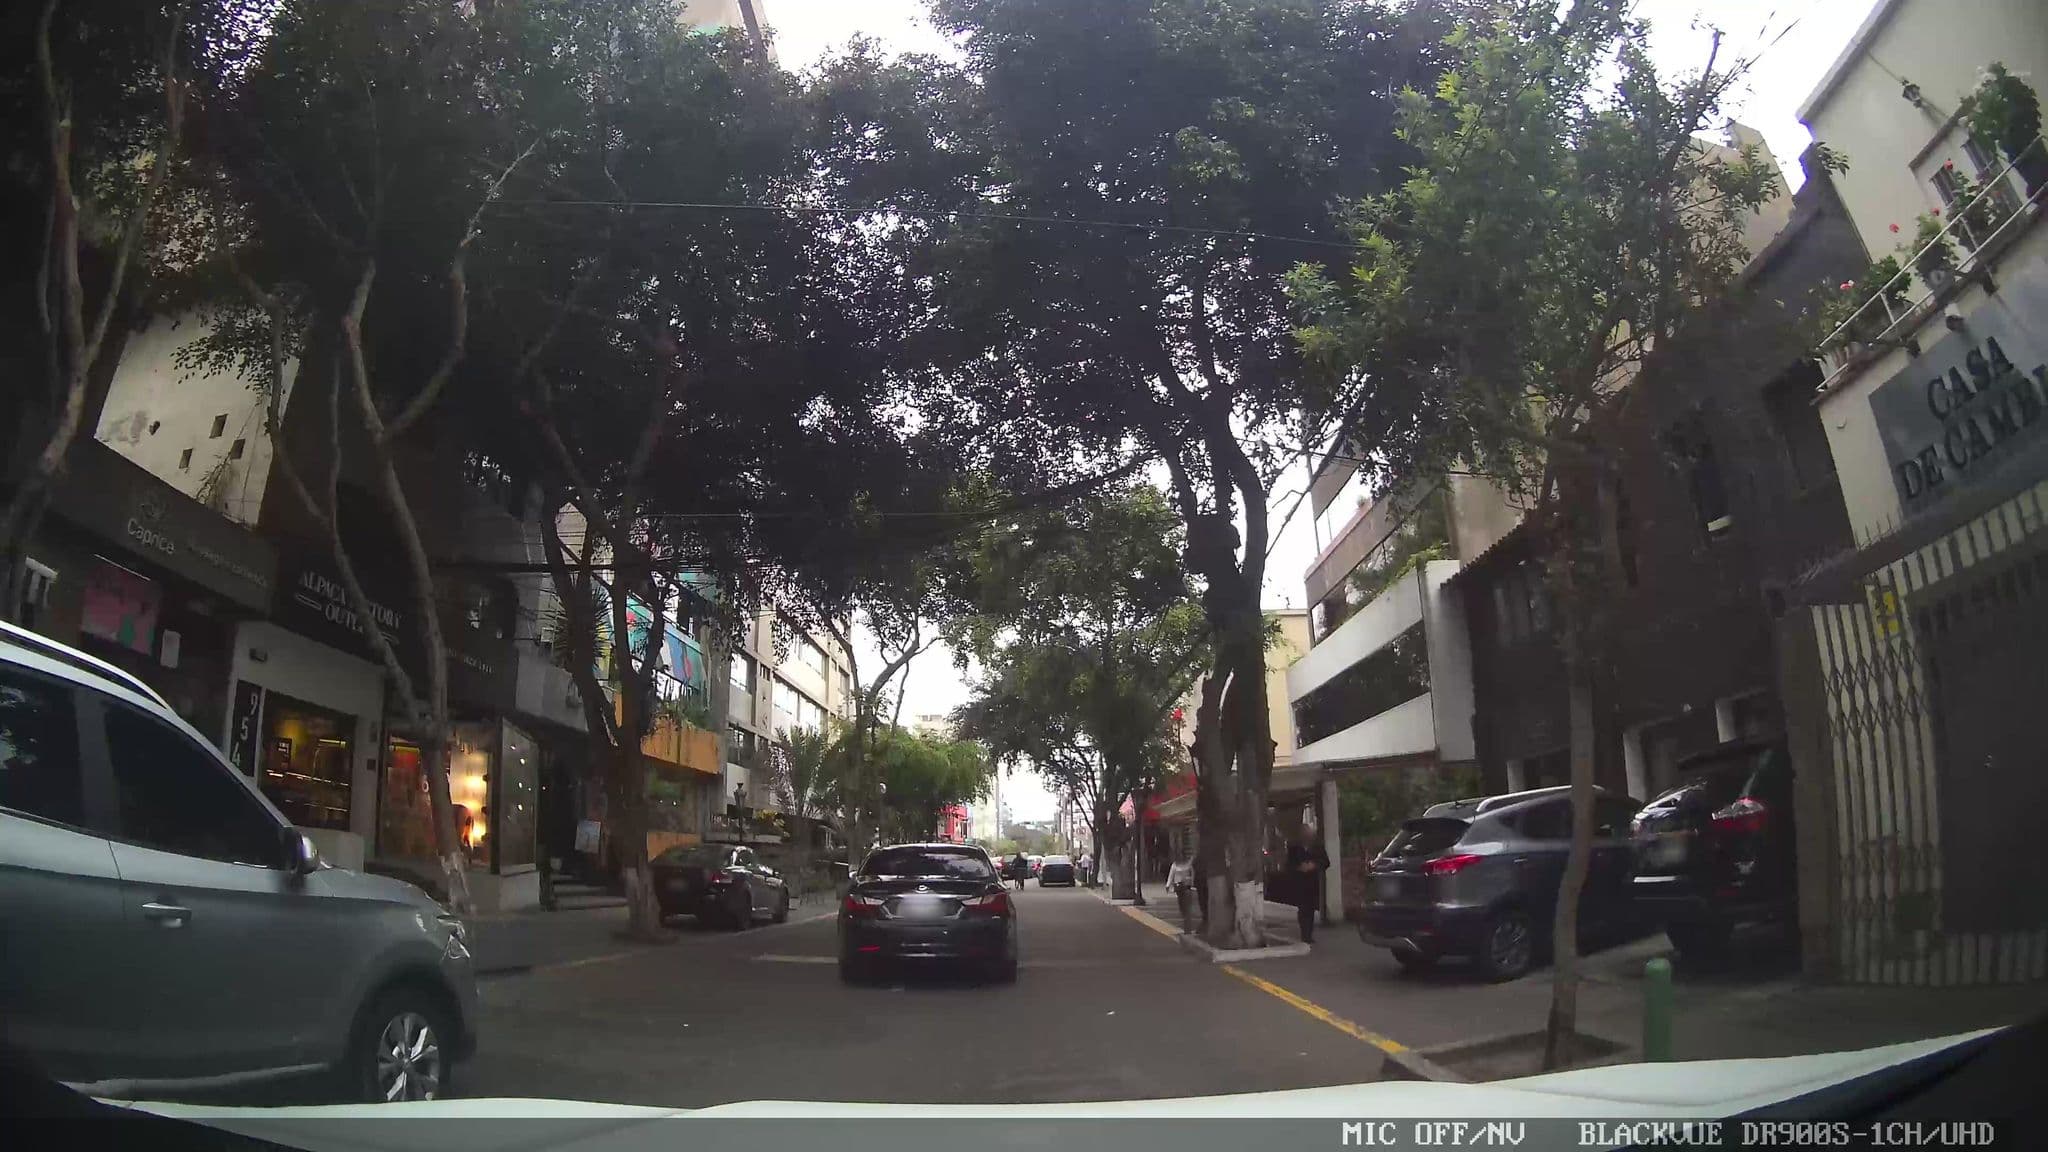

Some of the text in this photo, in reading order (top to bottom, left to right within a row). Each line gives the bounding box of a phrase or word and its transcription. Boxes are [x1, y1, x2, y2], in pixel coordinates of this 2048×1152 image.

[1928, 336, 2014, 420] CASA
[1900, 443, 1945, 498] DE
[127, 517, 175, 555] Caprice
[299, 571, 346, 606] ALPACA
